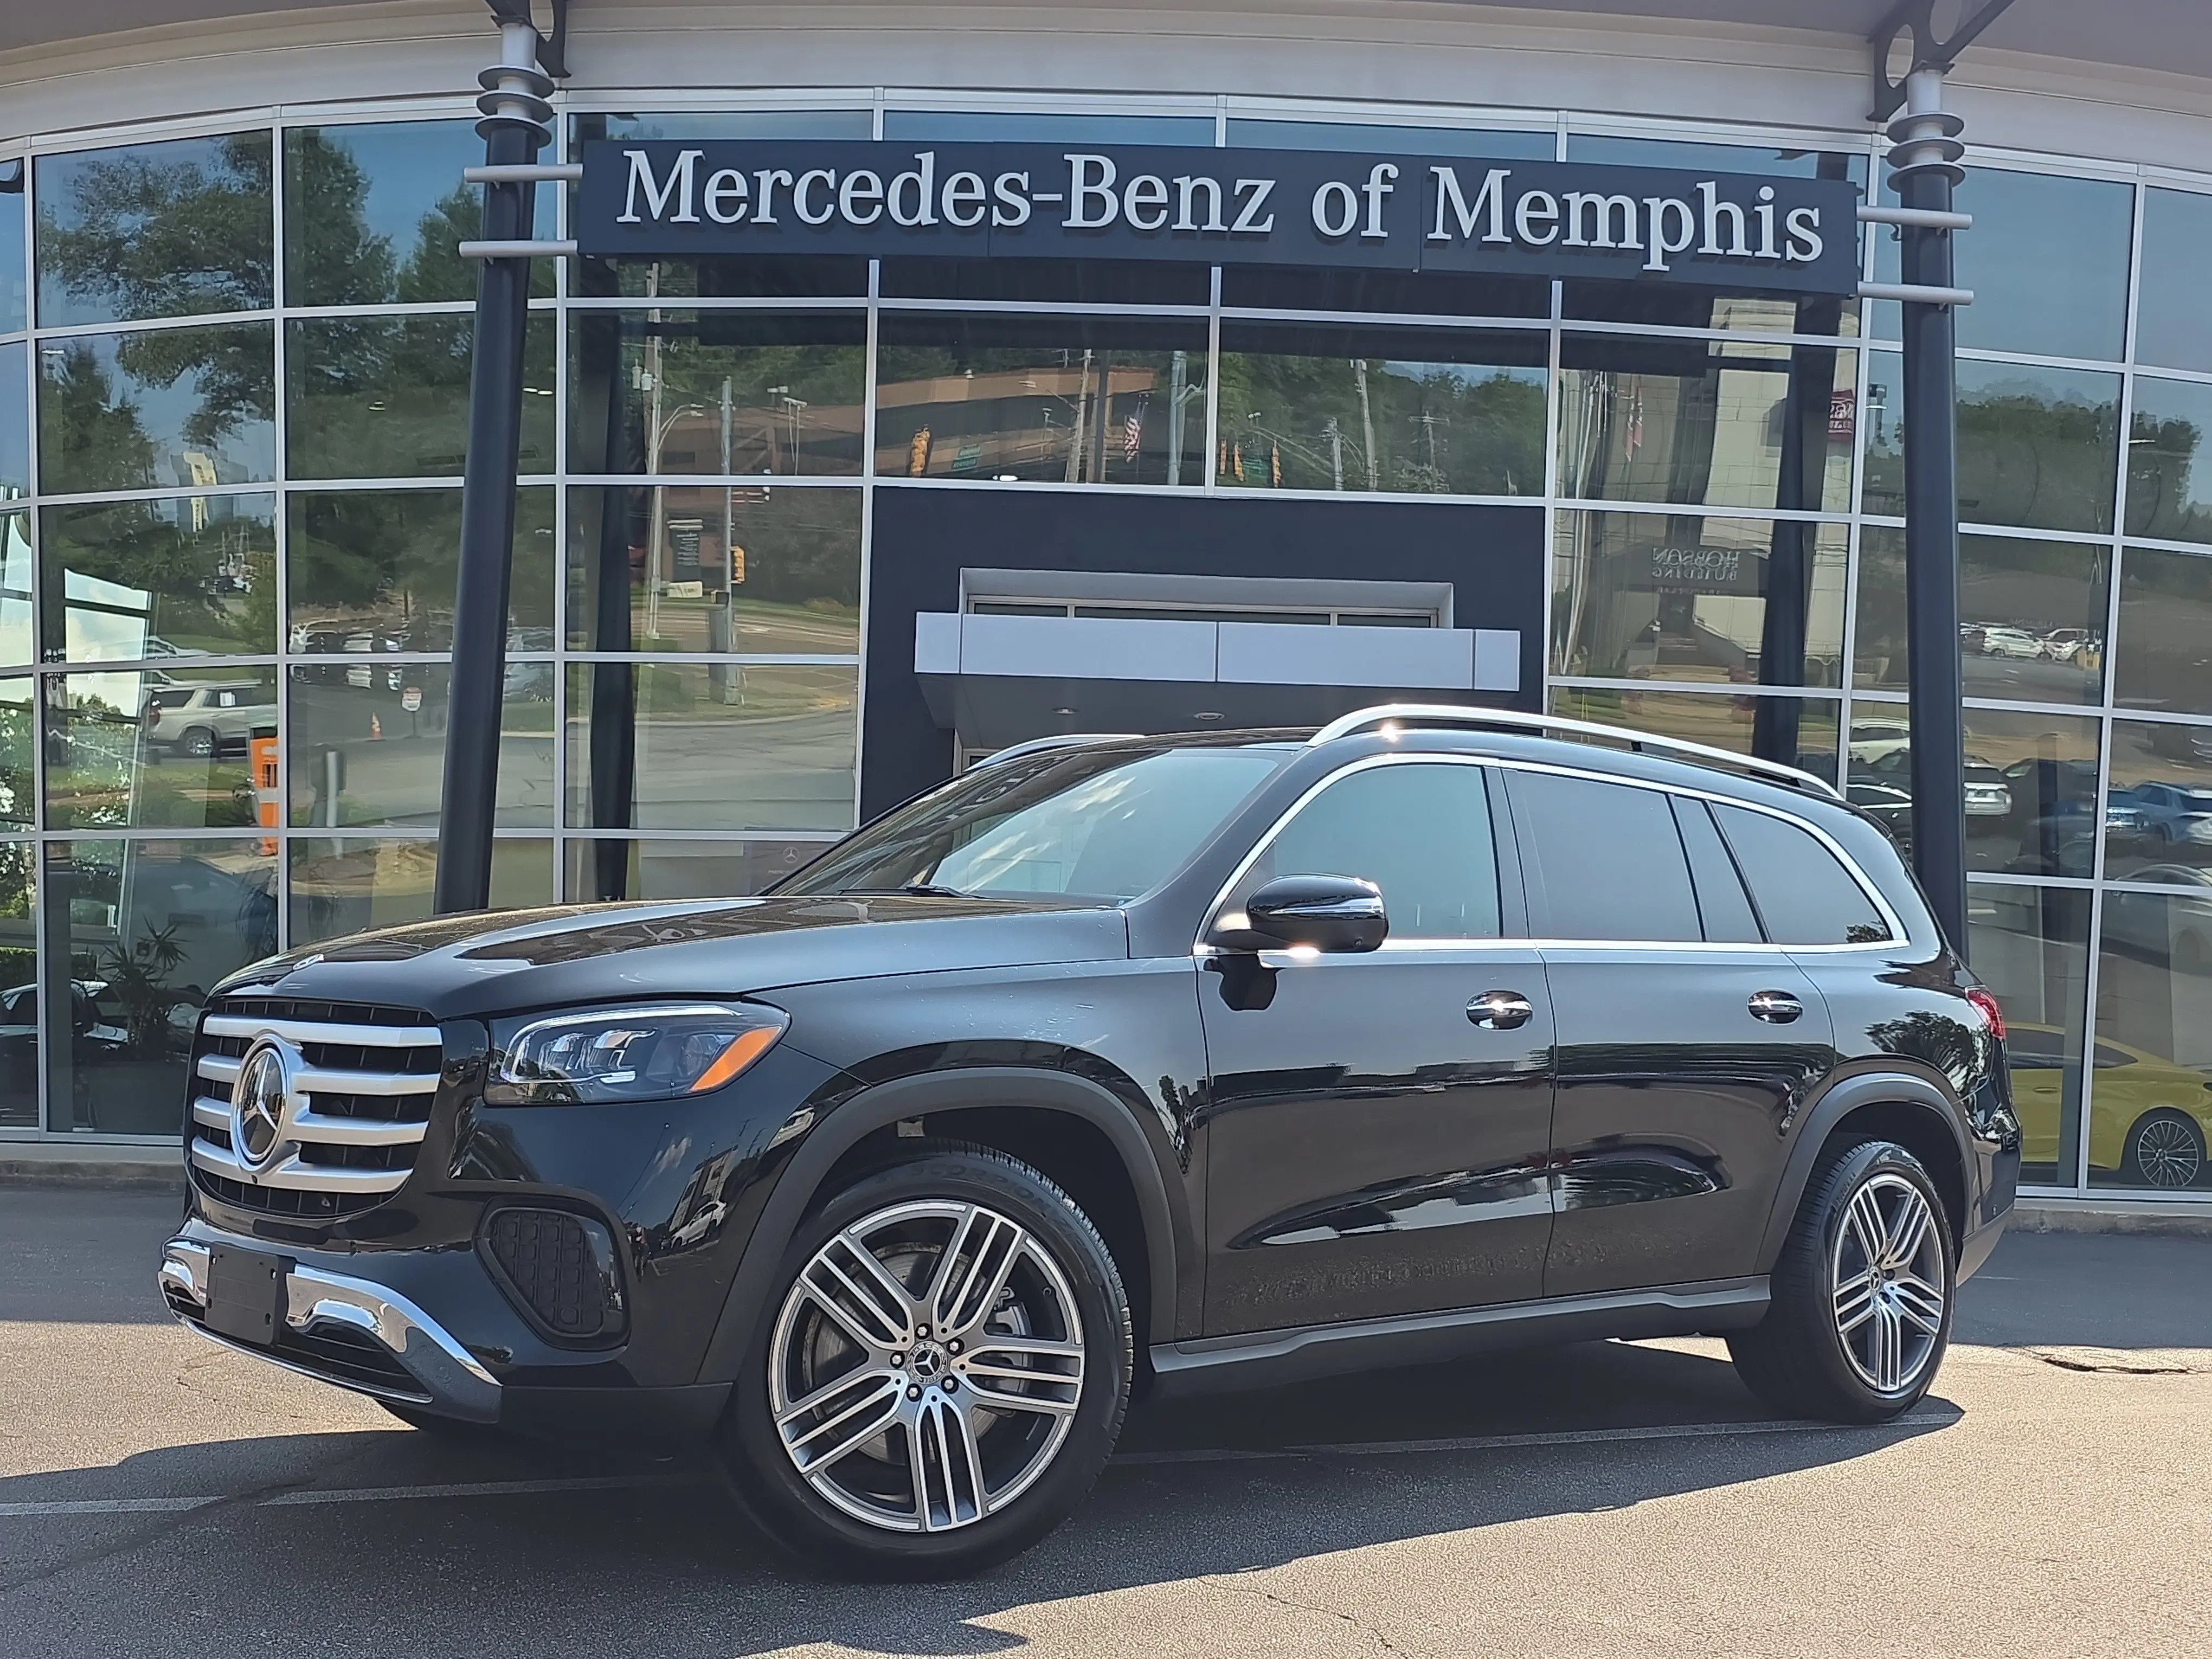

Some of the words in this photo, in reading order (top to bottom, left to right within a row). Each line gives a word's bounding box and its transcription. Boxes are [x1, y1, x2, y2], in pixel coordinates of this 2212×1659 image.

[616, 149, 1276, 234] Mercedes-Benz
[1311, 163, 1400, 238] of
[1426, 165, 1823, 272] Memphis
